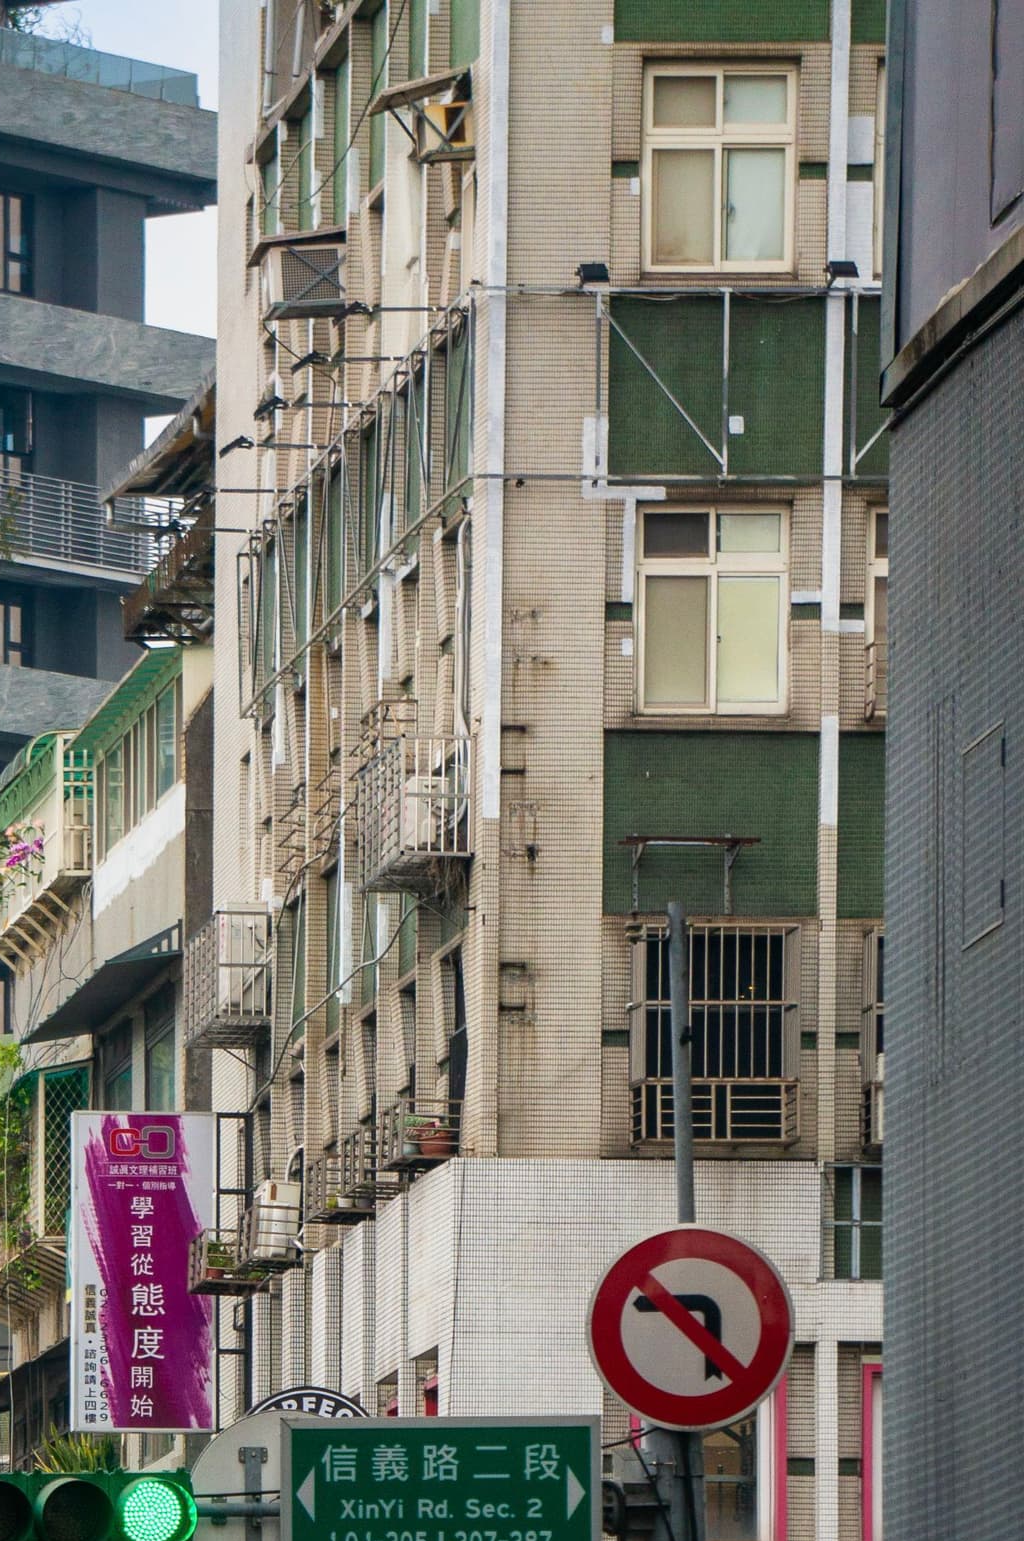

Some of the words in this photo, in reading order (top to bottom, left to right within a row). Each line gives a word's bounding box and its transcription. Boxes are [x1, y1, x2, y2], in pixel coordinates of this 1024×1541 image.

[130, 1196, 165, 1418] 學習從態度開始
[321, 1444, 561, 1482] 信義路二段
[340, 1499, 404, 1519] XinYi
[418, 1500, 454, 1519] Rd.
[466, 1500, 516, 1519] Sec.
[527, 1500, 543, 1518] 2
